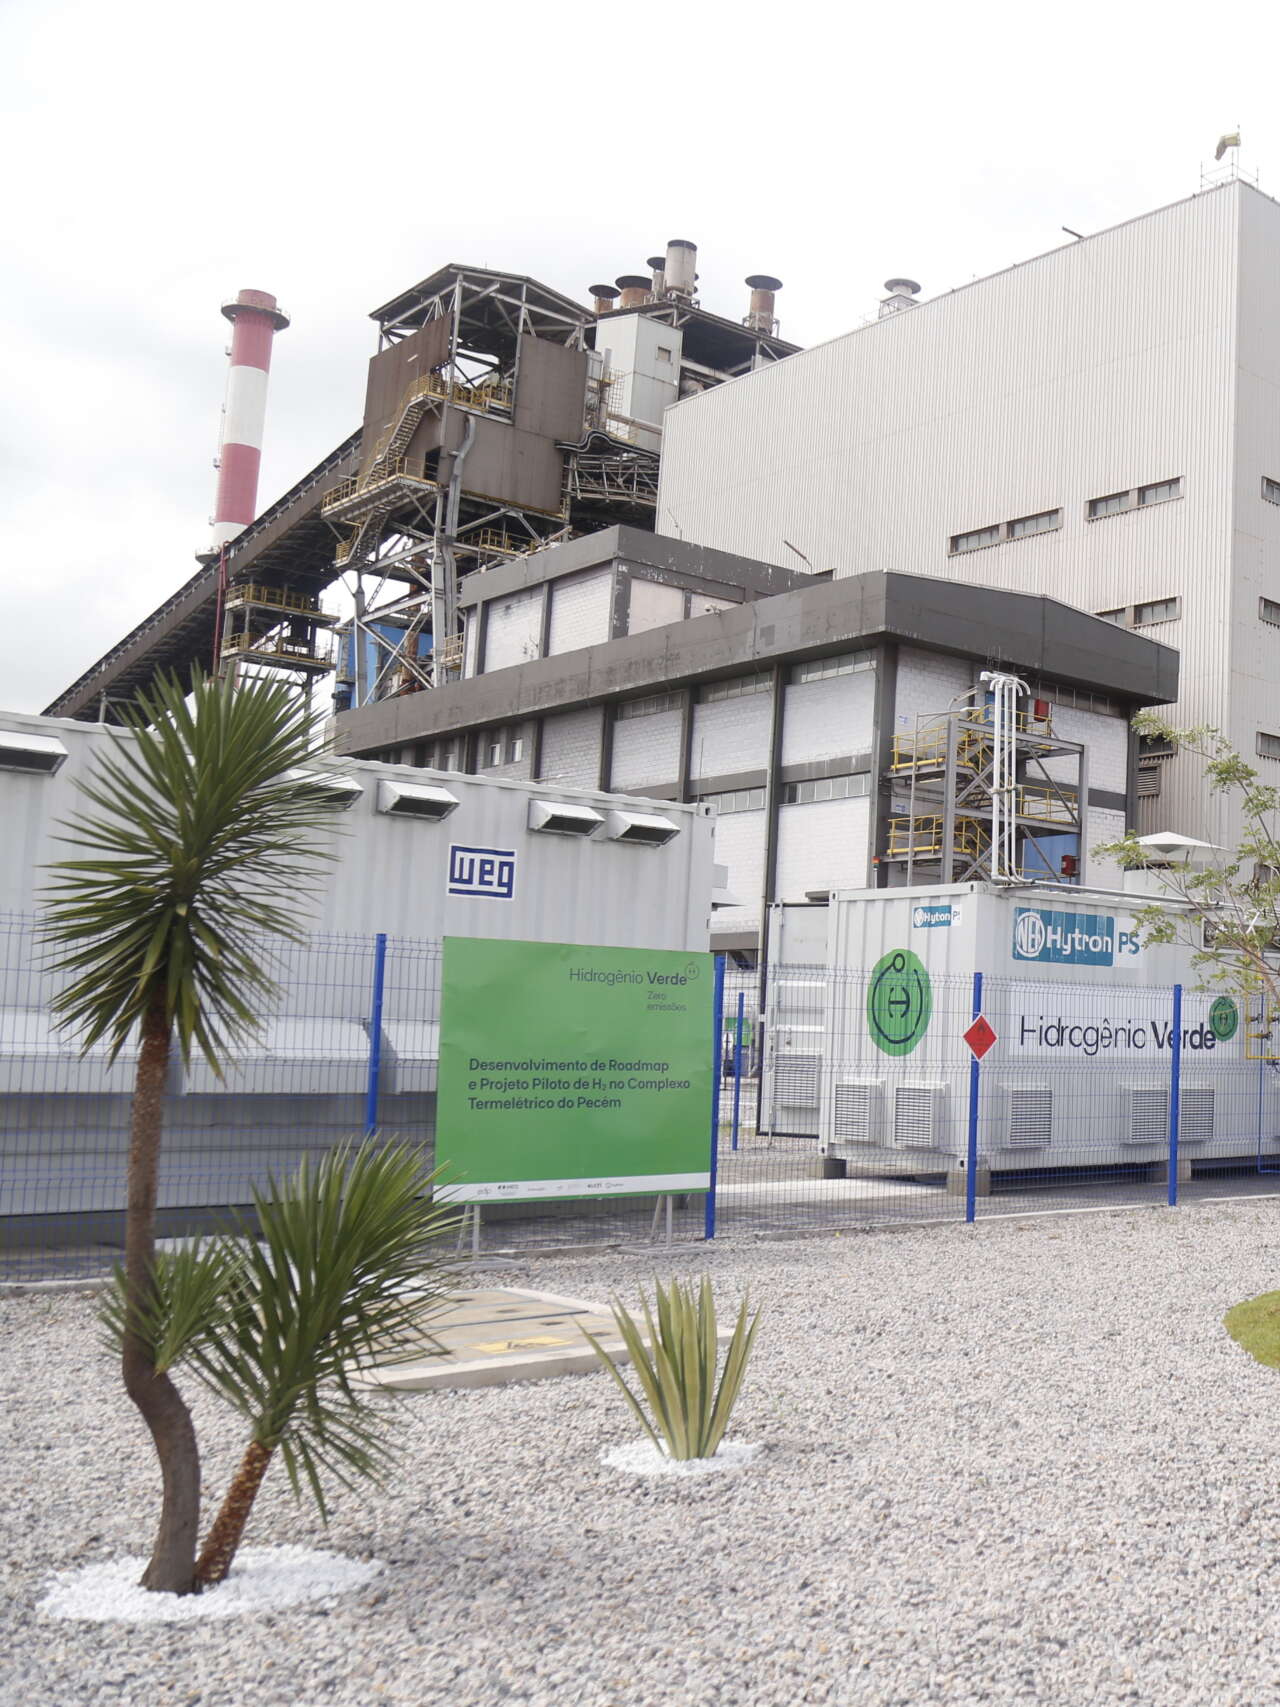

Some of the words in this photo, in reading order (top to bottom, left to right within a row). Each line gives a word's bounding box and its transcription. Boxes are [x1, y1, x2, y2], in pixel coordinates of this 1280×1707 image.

[1046, 926, 1112, 956] Hytron
[1118, 931, 1140, 955] PS
[569, 968, 644, 986] Hidrogênio
[647, 971, 688, 985] Verde
[1020, 1015, 1146, 1056] Hidrogênio
[469, 1058, 588, 1071] Desenvolvimento
[590, 1059, 606, 1071] de
[608, 1059, 669, 1074] Roadmap
[468, 1080, 477, 1090] e
[480, 1077, 529, 1093] Projeto
[532, 1077, 570, 1090] Piloto
[573, 1077, 589, 1090] de
[609, 1080, 625, 1090] no
[627, 1077, 690, 1092] Complexo
[468, 1096, 555, 1110] Termelétrico
[557, 1097, 575, 1109] do
[577, 1095, 621, 1109] Pecém
